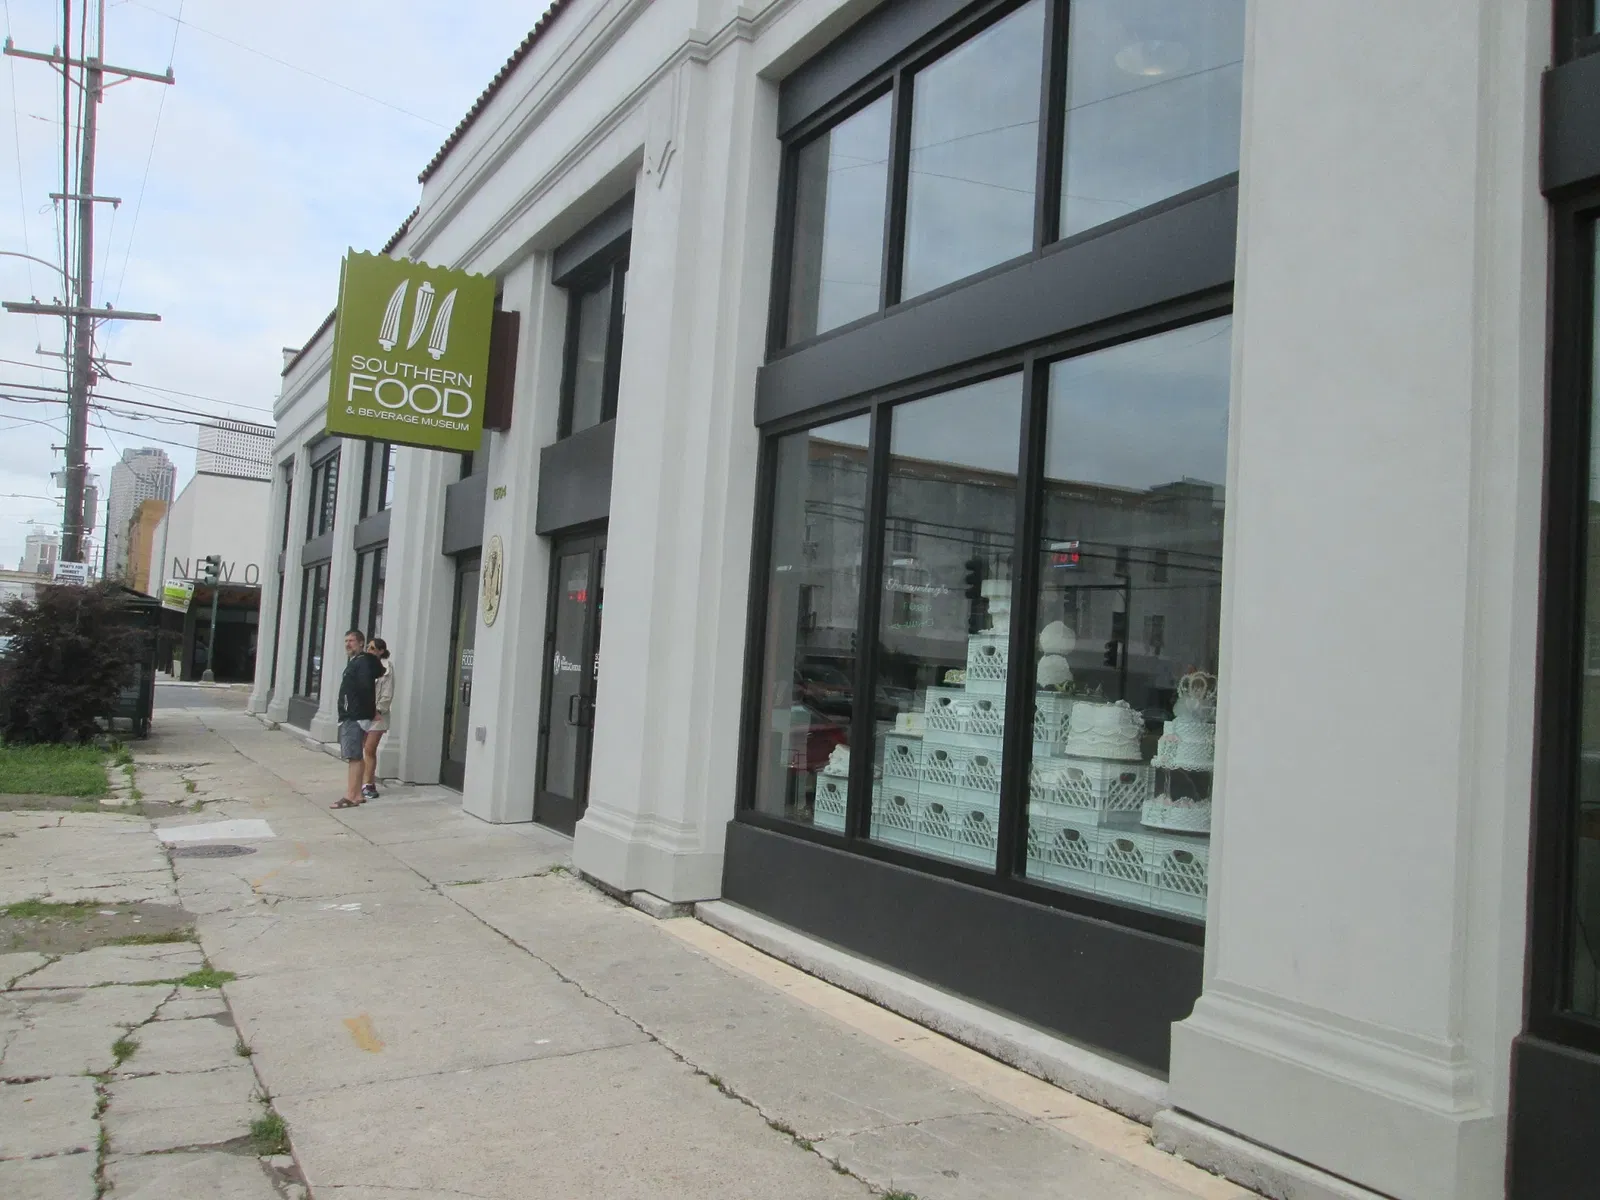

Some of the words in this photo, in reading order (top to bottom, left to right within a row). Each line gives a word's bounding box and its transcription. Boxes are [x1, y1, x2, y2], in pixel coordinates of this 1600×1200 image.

[351, 355, 473, 388] SOUTHERN
[347, 373, 473, 418] FOOD
[345, 405, 355, 415] &
[358, 407, 419, 424] BEVERAGE
[421, 417, 470, 431] MUSEUM
